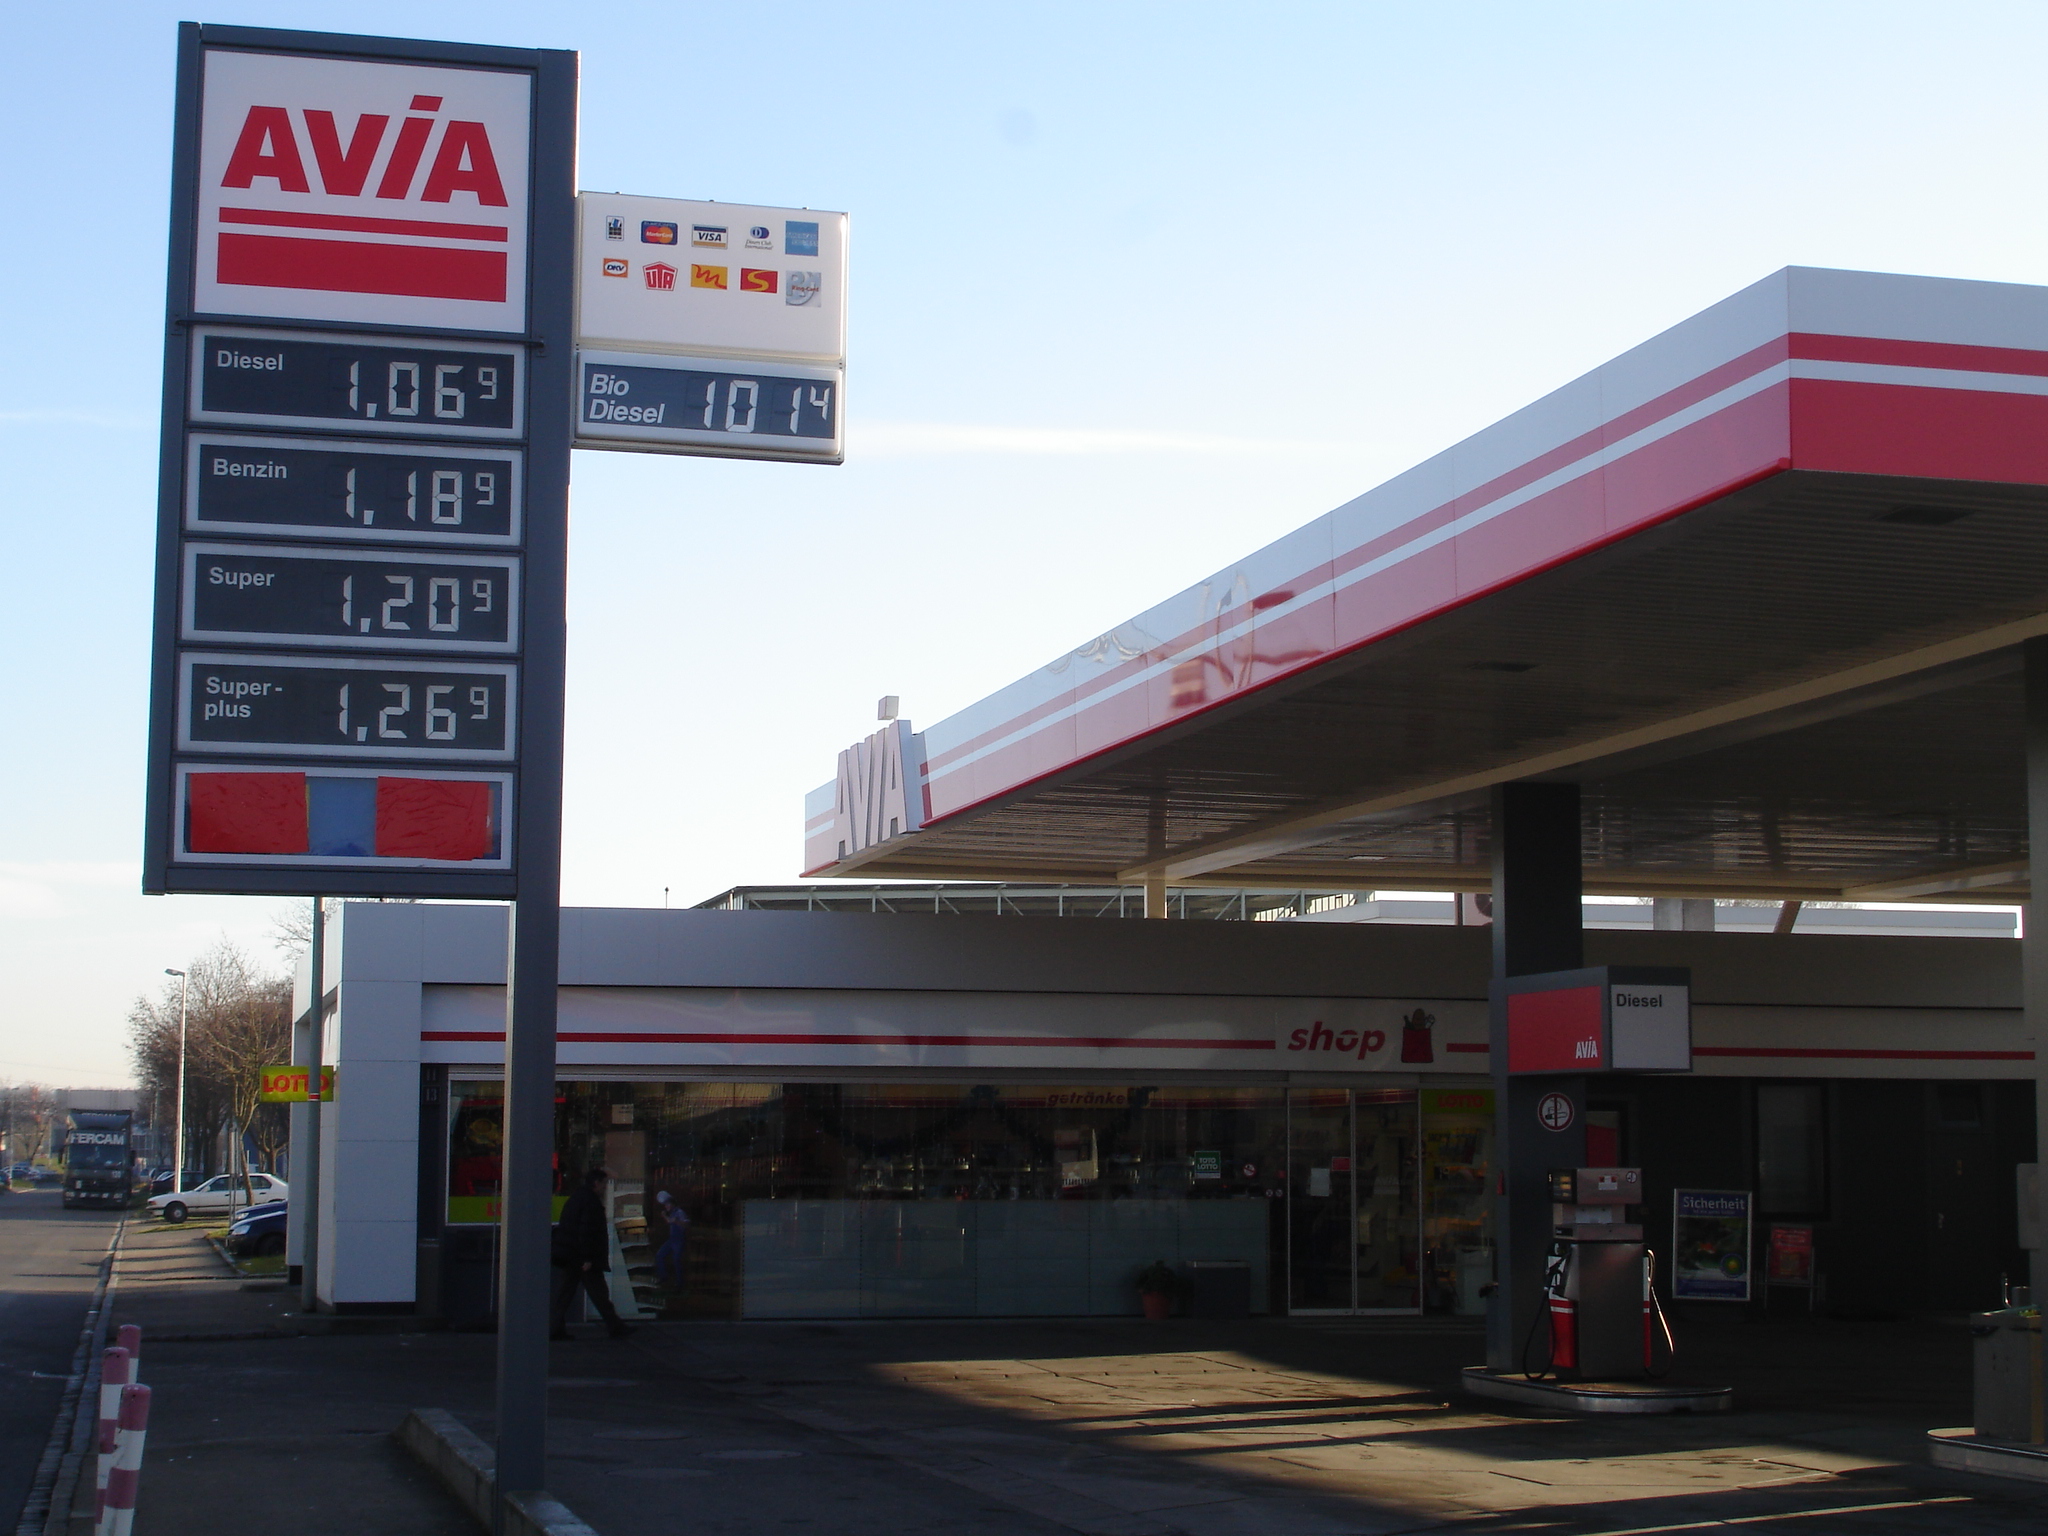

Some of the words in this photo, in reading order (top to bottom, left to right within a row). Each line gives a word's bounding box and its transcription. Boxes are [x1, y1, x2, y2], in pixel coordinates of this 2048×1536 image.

[698, 231, 722, 242] VISA
[606, 264, 625, 272] DKV
[217, 350, 283, 371] Diesel
[589, 374, 630, 396] Bio
[588, 399, 665, 424] Diesel
[213, 458, 288, 479] Benzin
[209, 566, 275, 590] Super
[204, 699, 251, 721] plus
[1616, 993, 1663, 1008] Diesel
[1287, 1020, 1387, 1060] shop
[1046, 1091, 1126, 1107] getränke
[1437, 1094, 1486, 1109] LOTTO
[70, 1133, 125, 1146] FERCAM
[1683, 1196, 1746, 1210] Sicherheit
